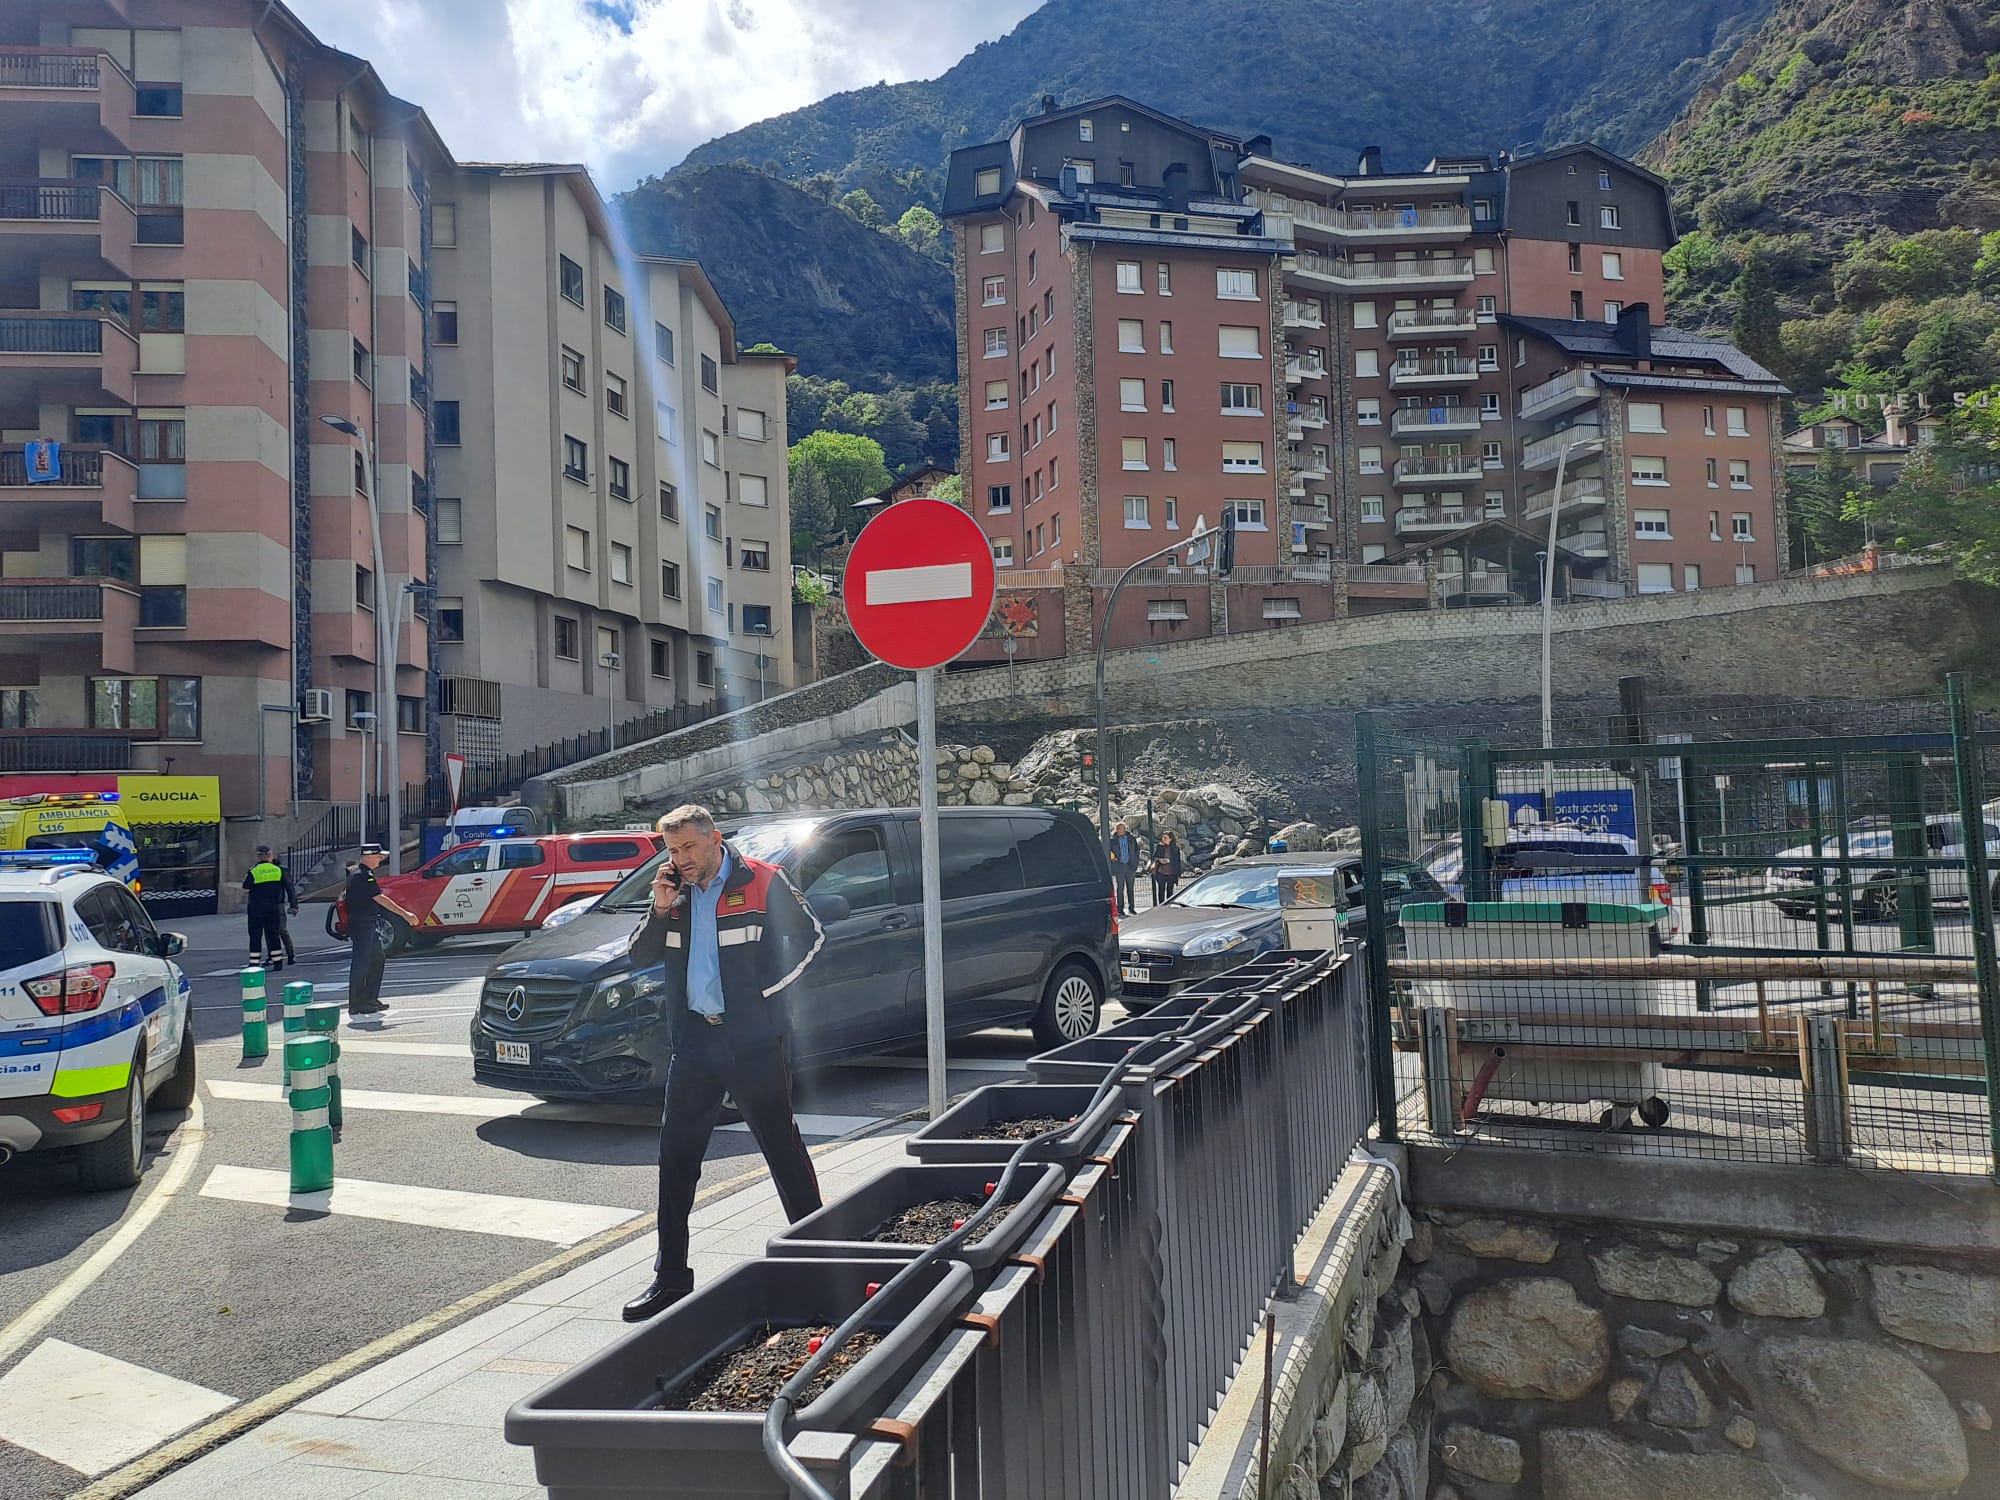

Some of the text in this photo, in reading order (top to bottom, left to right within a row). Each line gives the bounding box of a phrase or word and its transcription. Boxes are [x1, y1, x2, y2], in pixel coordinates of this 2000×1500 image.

[1833, 392, 1931, 410] HOTEL
[1555, 802, 1618, 815] onstruccions
[46, 823, 64, 833] 116
[507, 1044, 528, 1059] M3421
